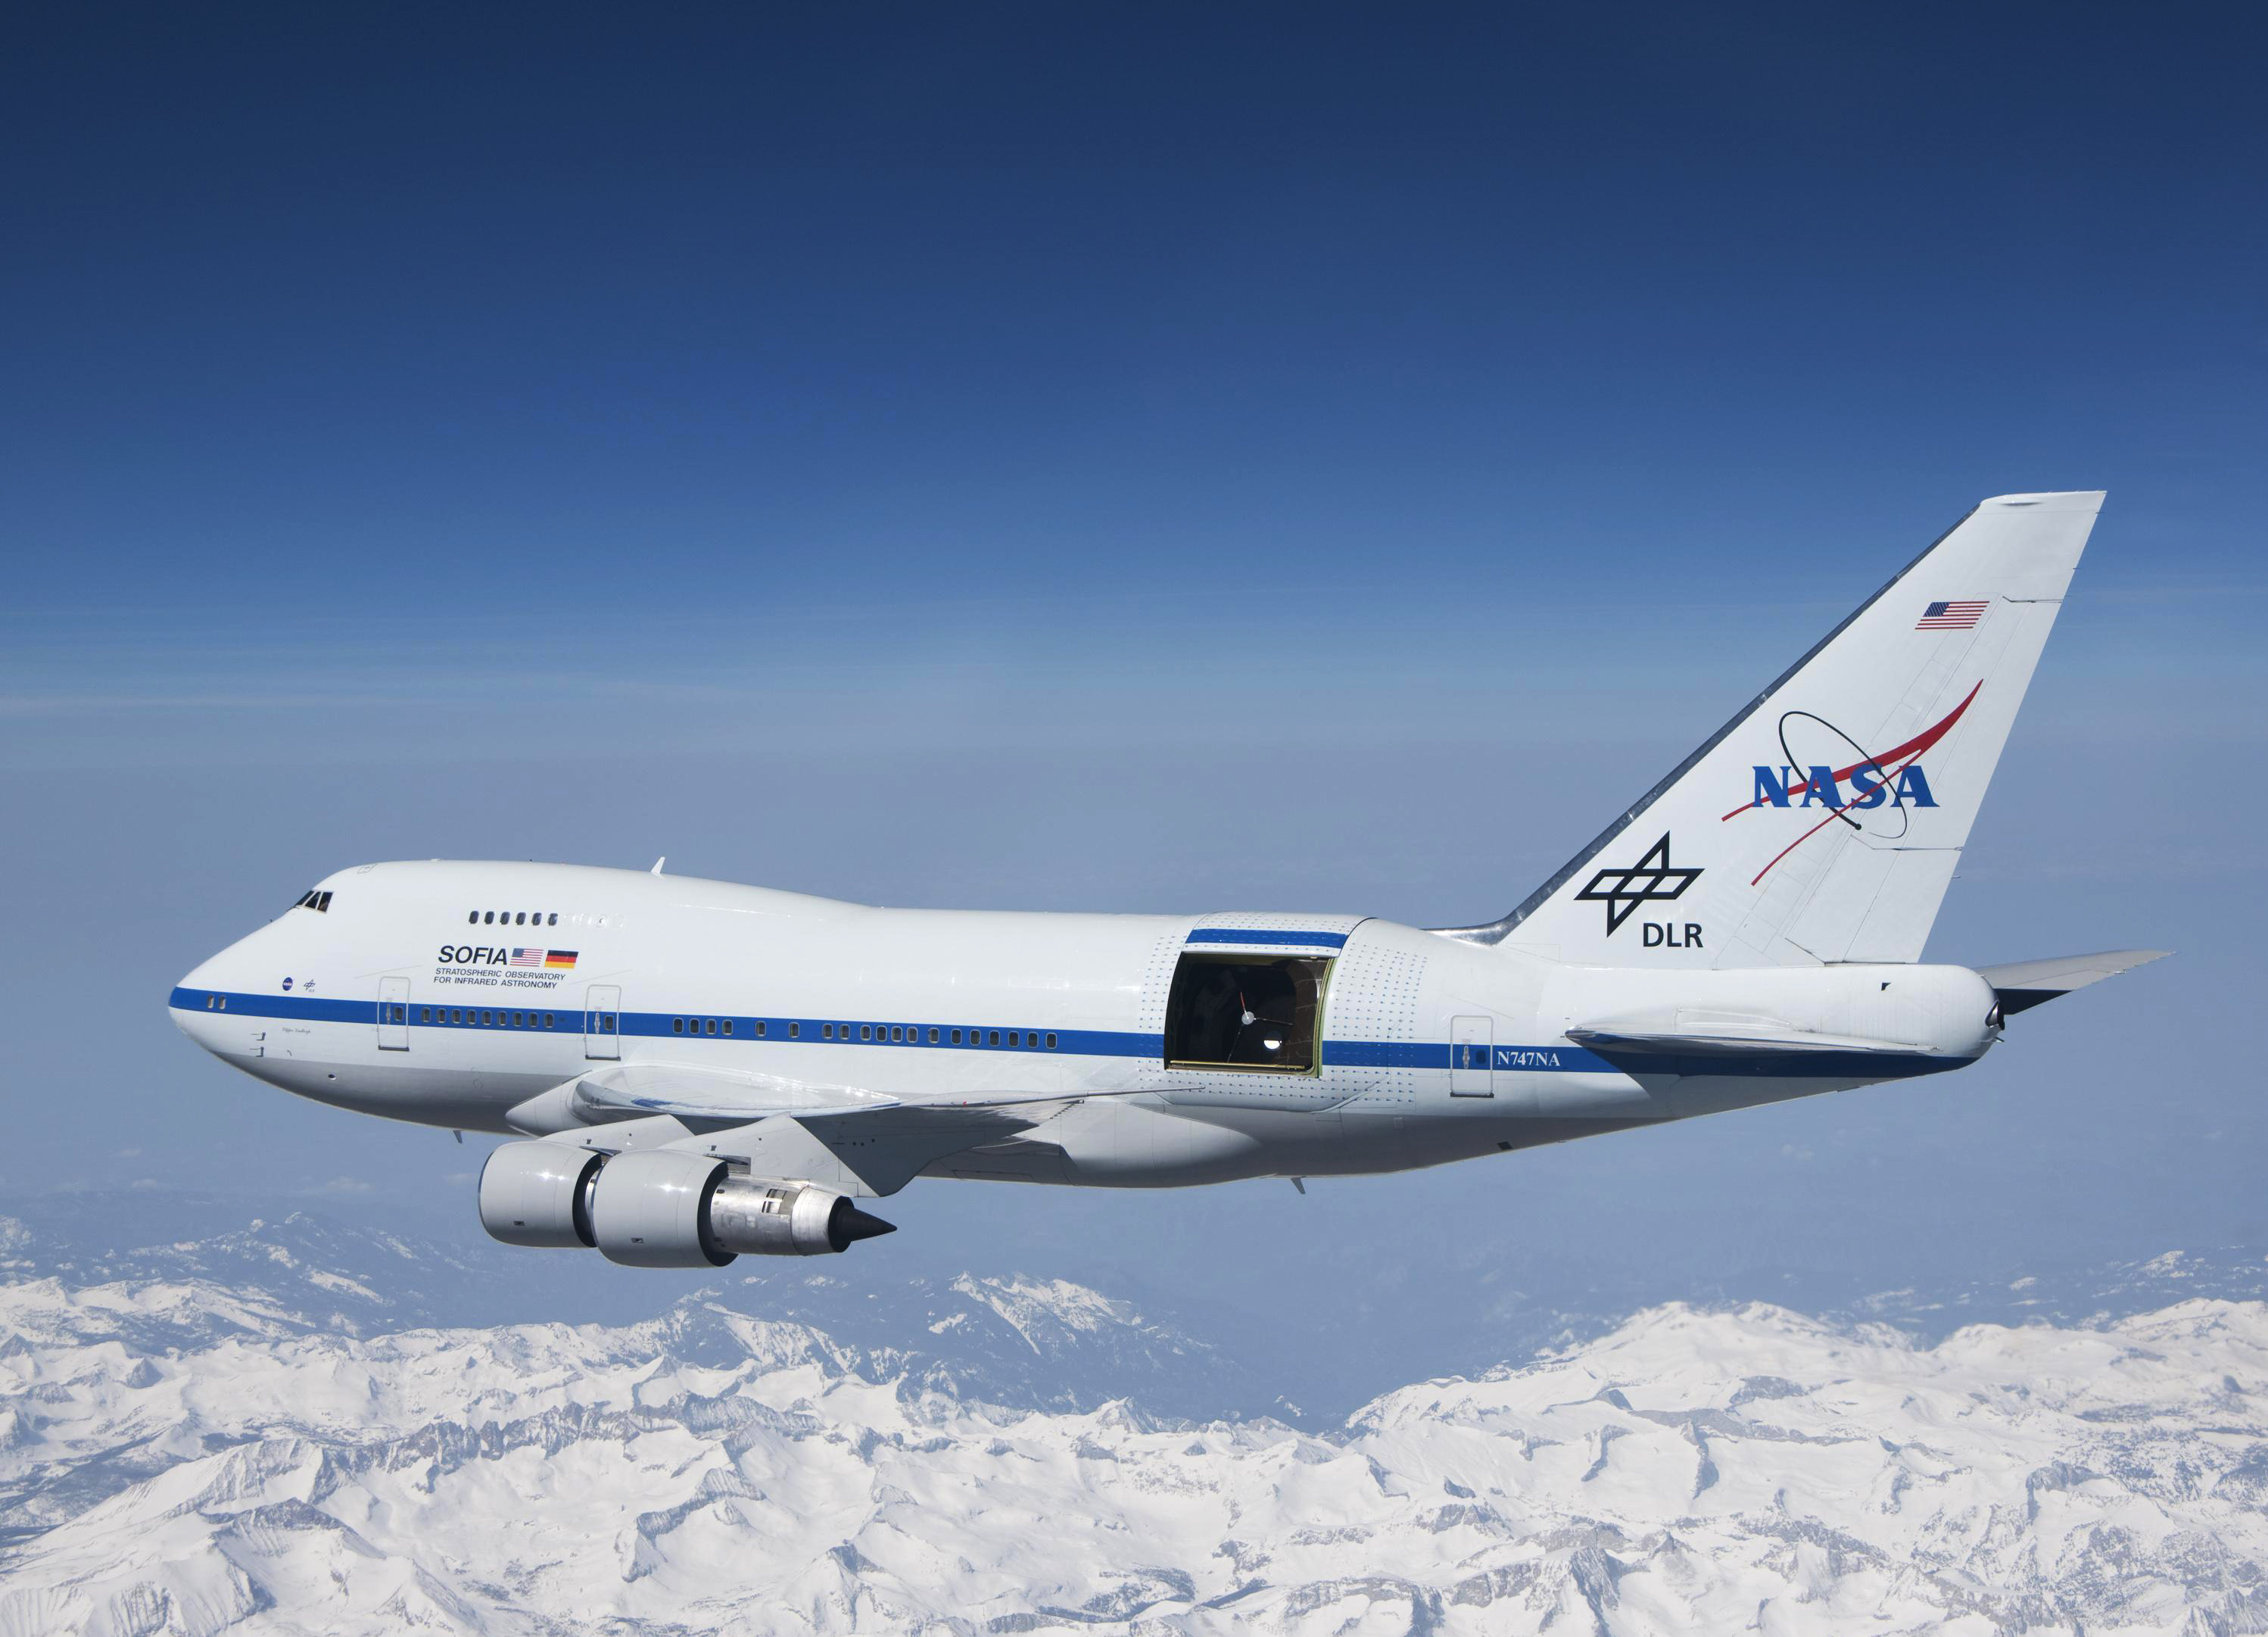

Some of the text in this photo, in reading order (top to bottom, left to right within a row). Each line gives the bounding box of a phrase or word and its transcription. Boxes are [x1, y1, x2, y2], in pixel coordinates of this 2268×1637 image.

[1752, 765, 1940, 809] NASA
[1643, 922, 1704, 948] DLR
[438, 945, 507, 965] SOFIA
[434, 976, 558, 989] FOR INFRARED ASTRONOMY
[435, 968, 566, 981] STRATOSPHERIC OBSERVATORY
[1497, 1051, 1561, 1067] N747NA
